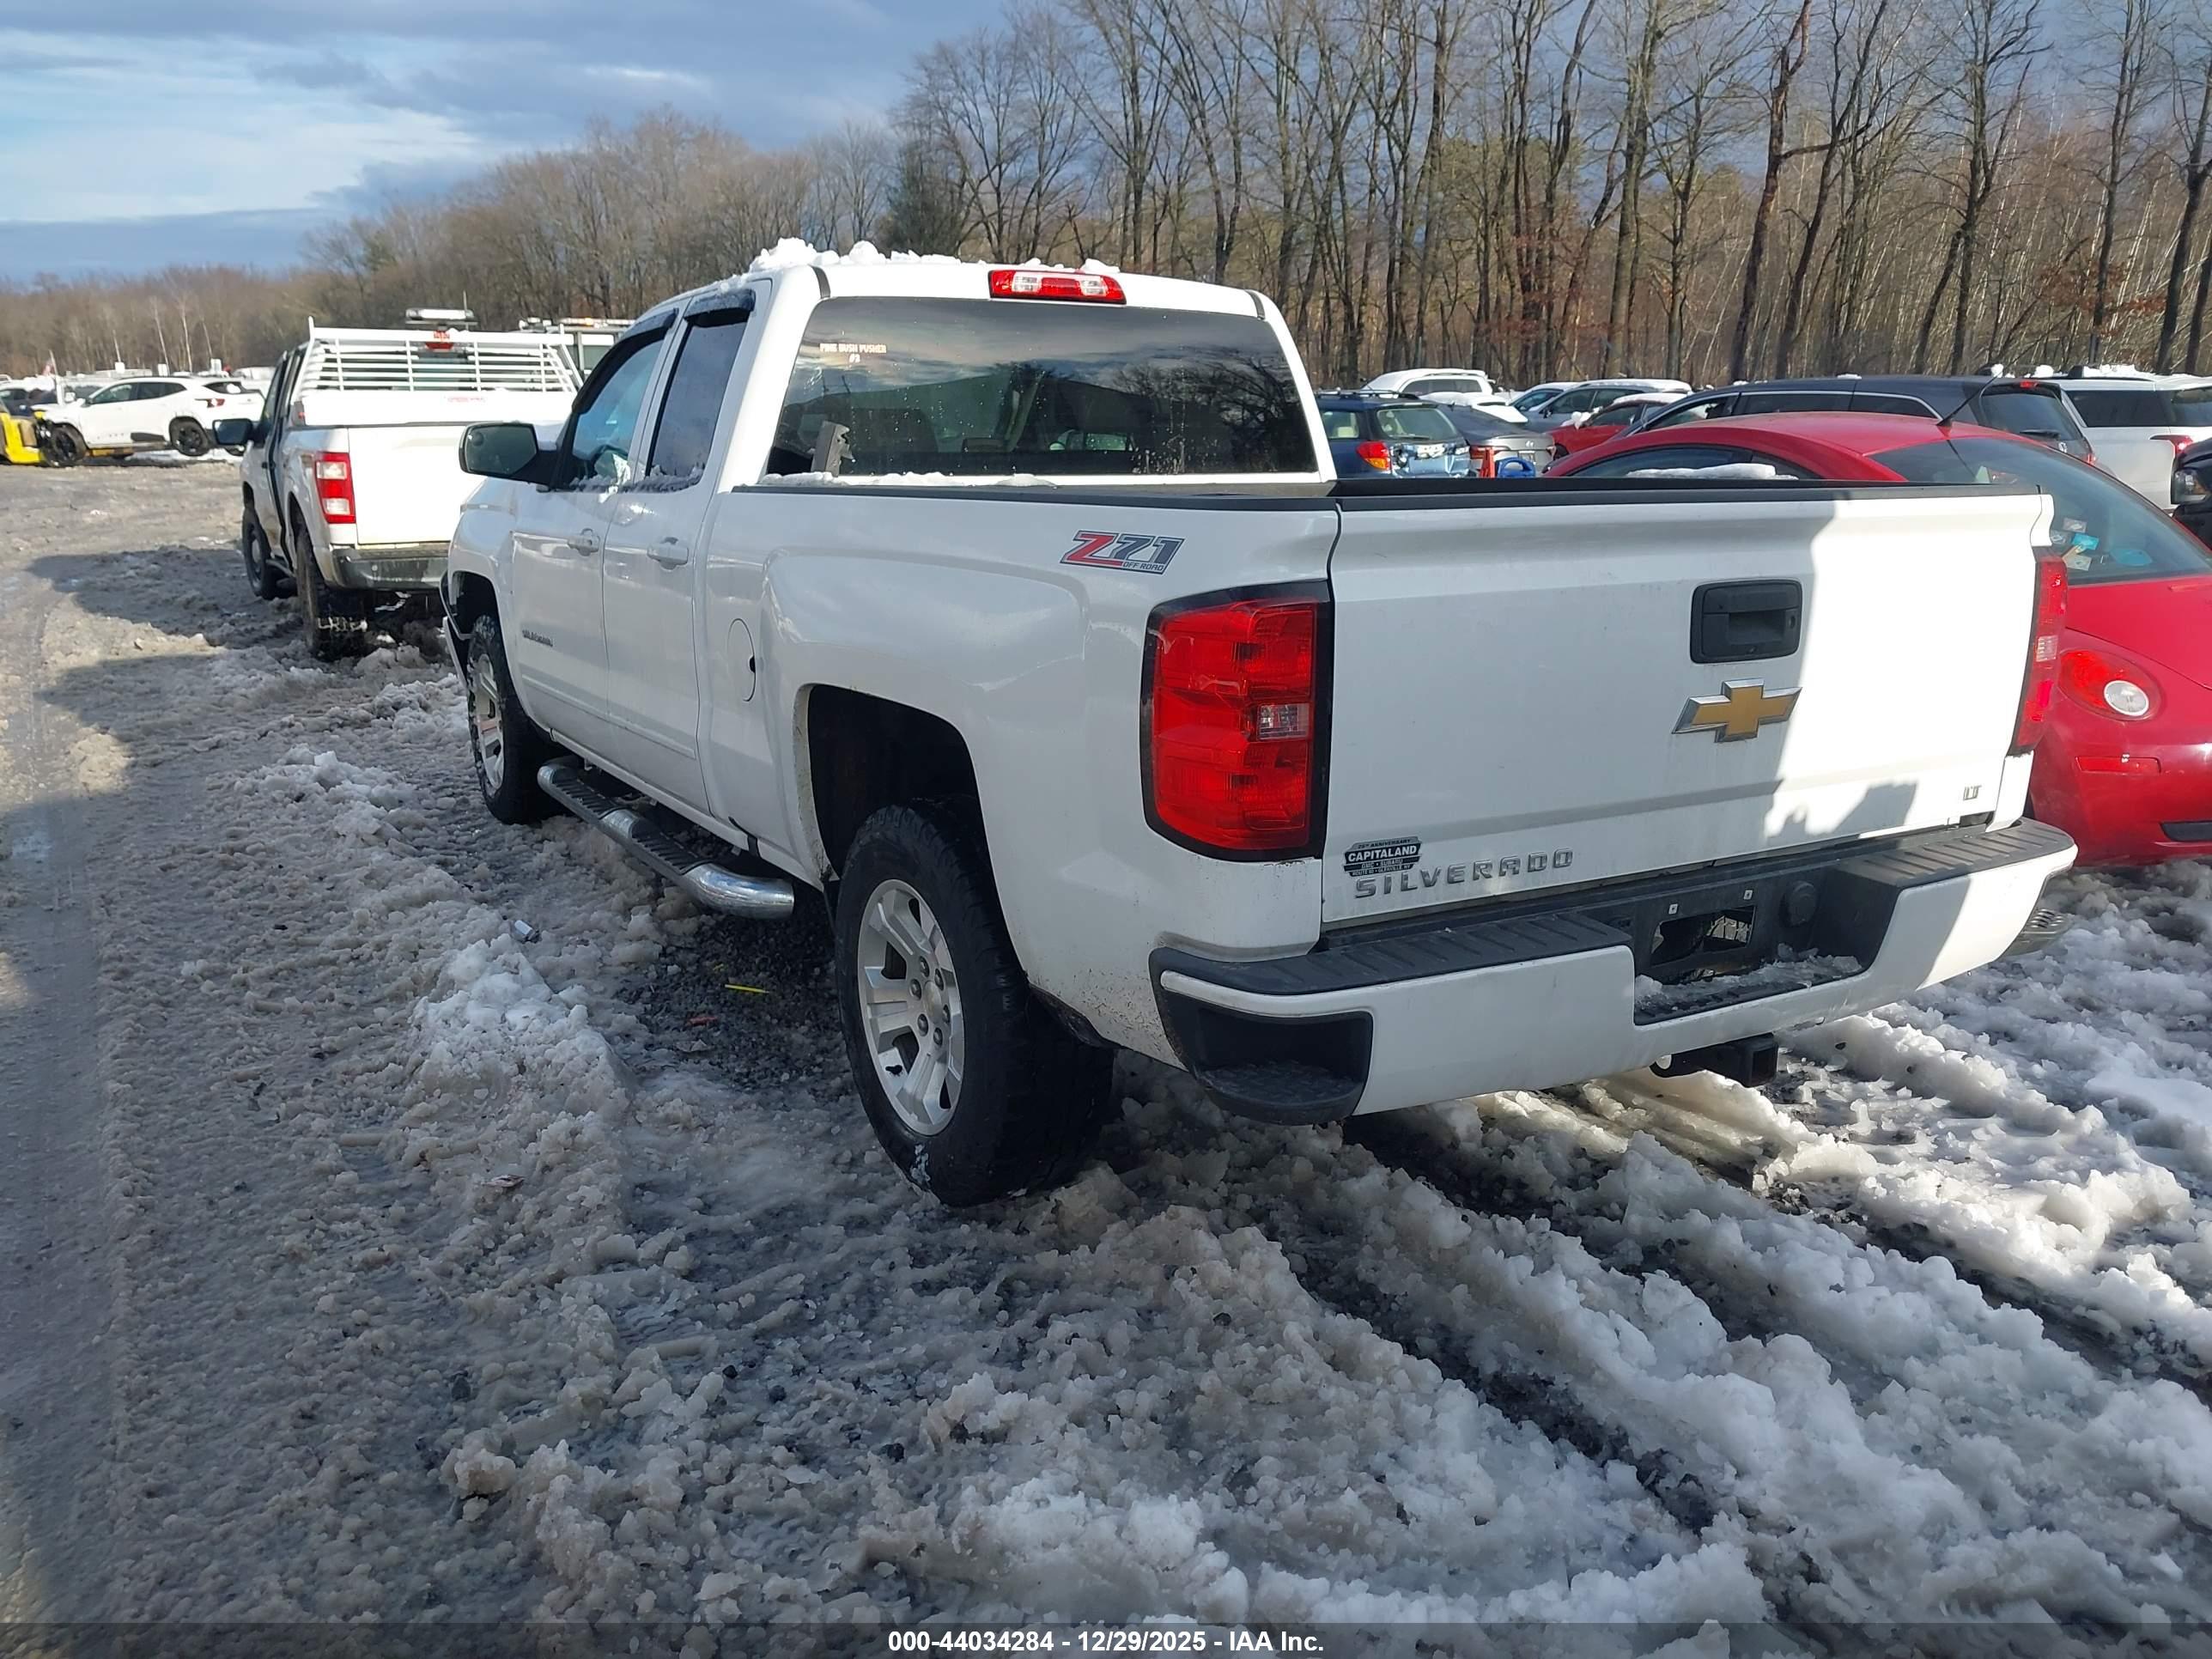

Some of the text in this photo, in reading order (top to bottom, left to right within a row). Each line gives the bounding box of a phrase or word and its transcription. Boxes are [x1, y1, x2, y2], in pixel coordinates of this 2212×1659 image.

[1060, 530, 1186, 574] Z71
[1122, 561, 1164, 572] OFF ROAD
[1962, 785, 1982, 801] LT
[1347, 845, 1418, 862] CAPITALAND
[1356, 848, 1573, 899] SILVERADO
